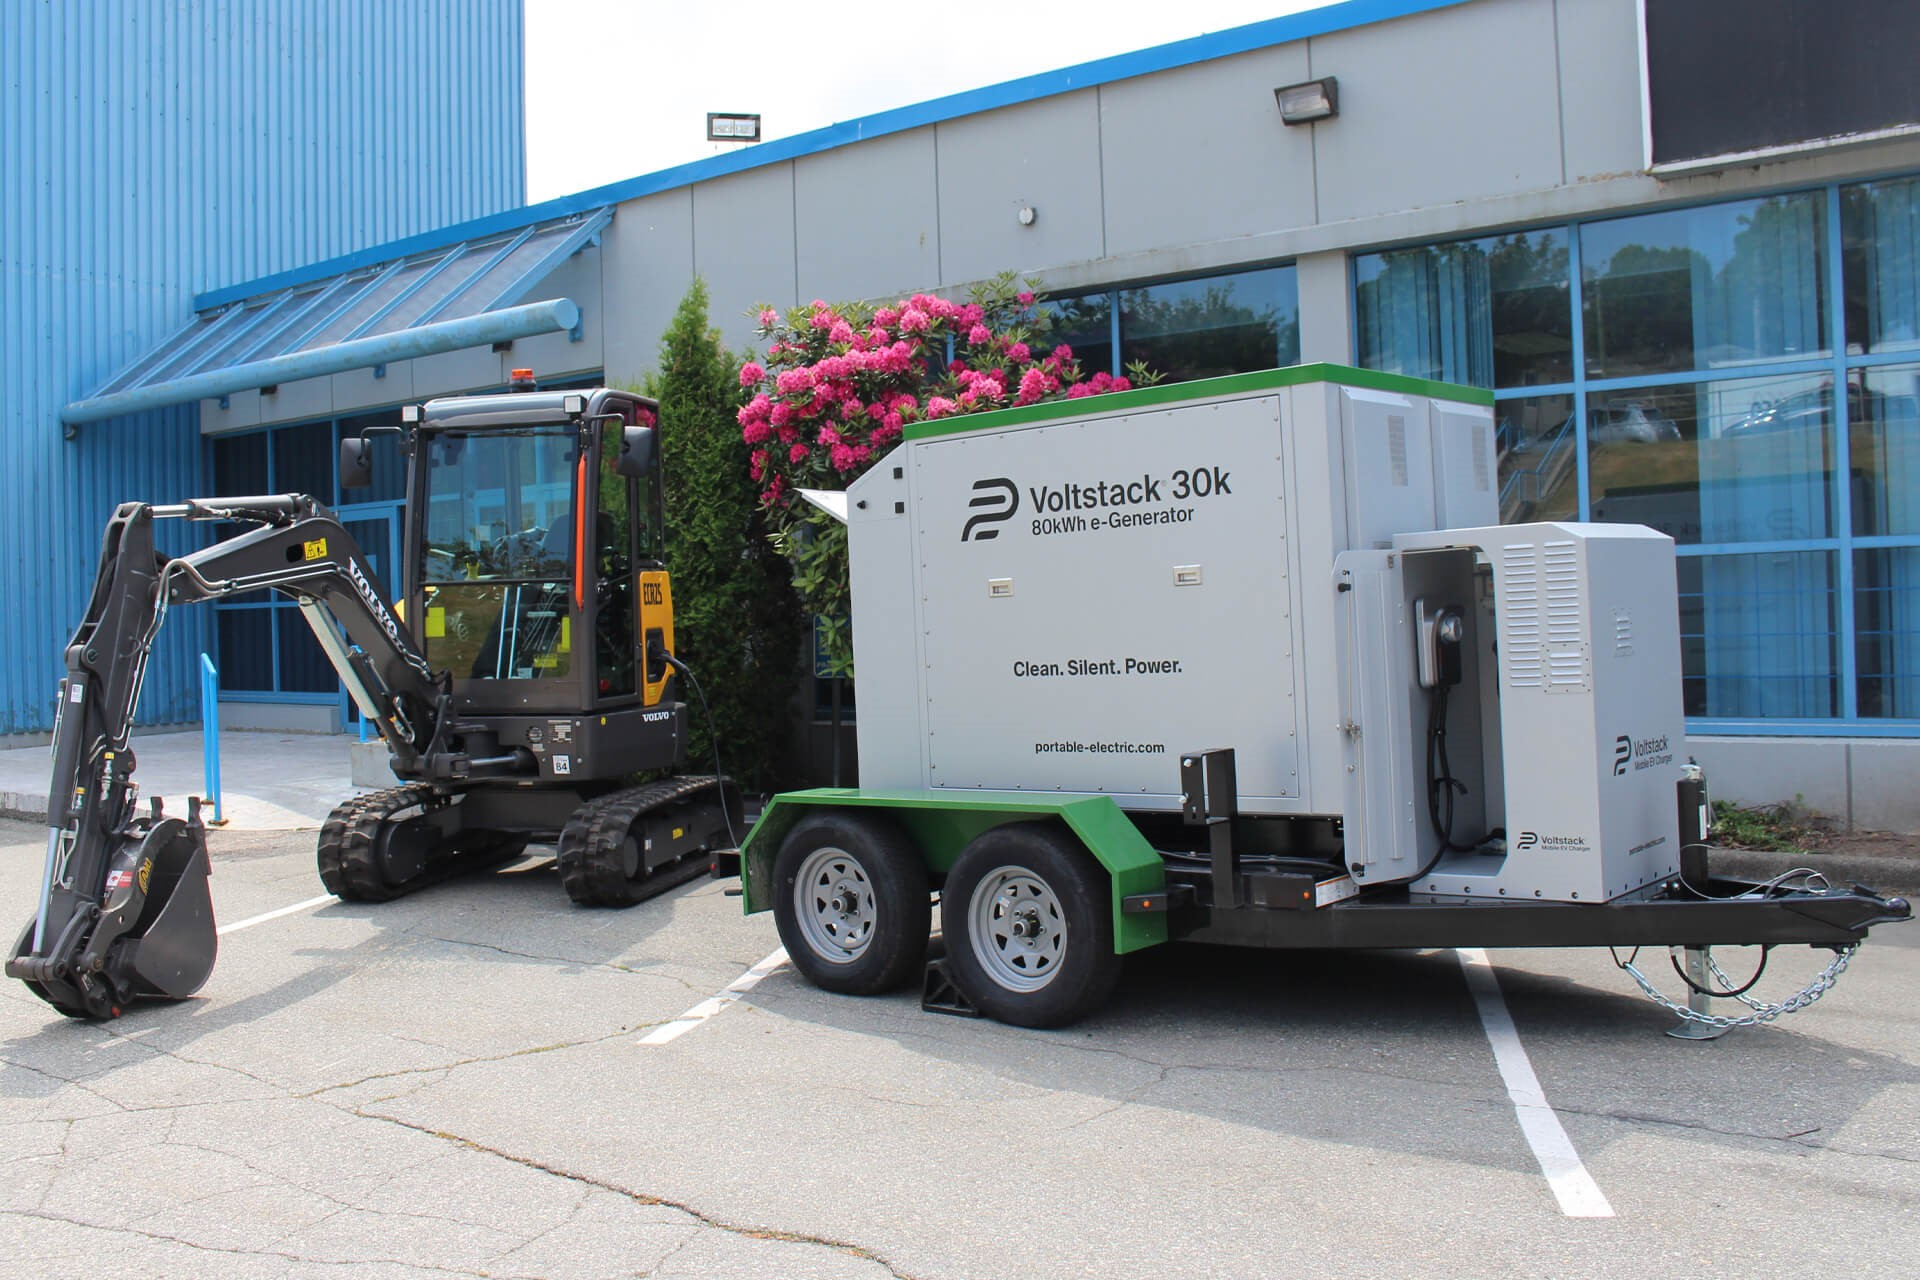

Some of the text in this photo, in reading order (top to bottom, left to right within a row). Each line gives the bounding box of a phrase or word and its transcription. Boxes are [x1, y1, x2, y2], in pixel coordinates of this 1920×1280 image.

[1029, 466, 1233, 514] Voltstack 30k
[1031, 506, 1195, 536] 80kWh e-Generator
[643, 582, 663, 605] ECR25
[1013, 658, 1182, 677] Clean. Silent. Power.
[642, 711, 669, 722] VOLVO
[1035, 740, 1165, 754] portable-electric.com
[1633, 735, 1668, 756] Voltstack
[1541, 836, 1584, 845] Voltstack
